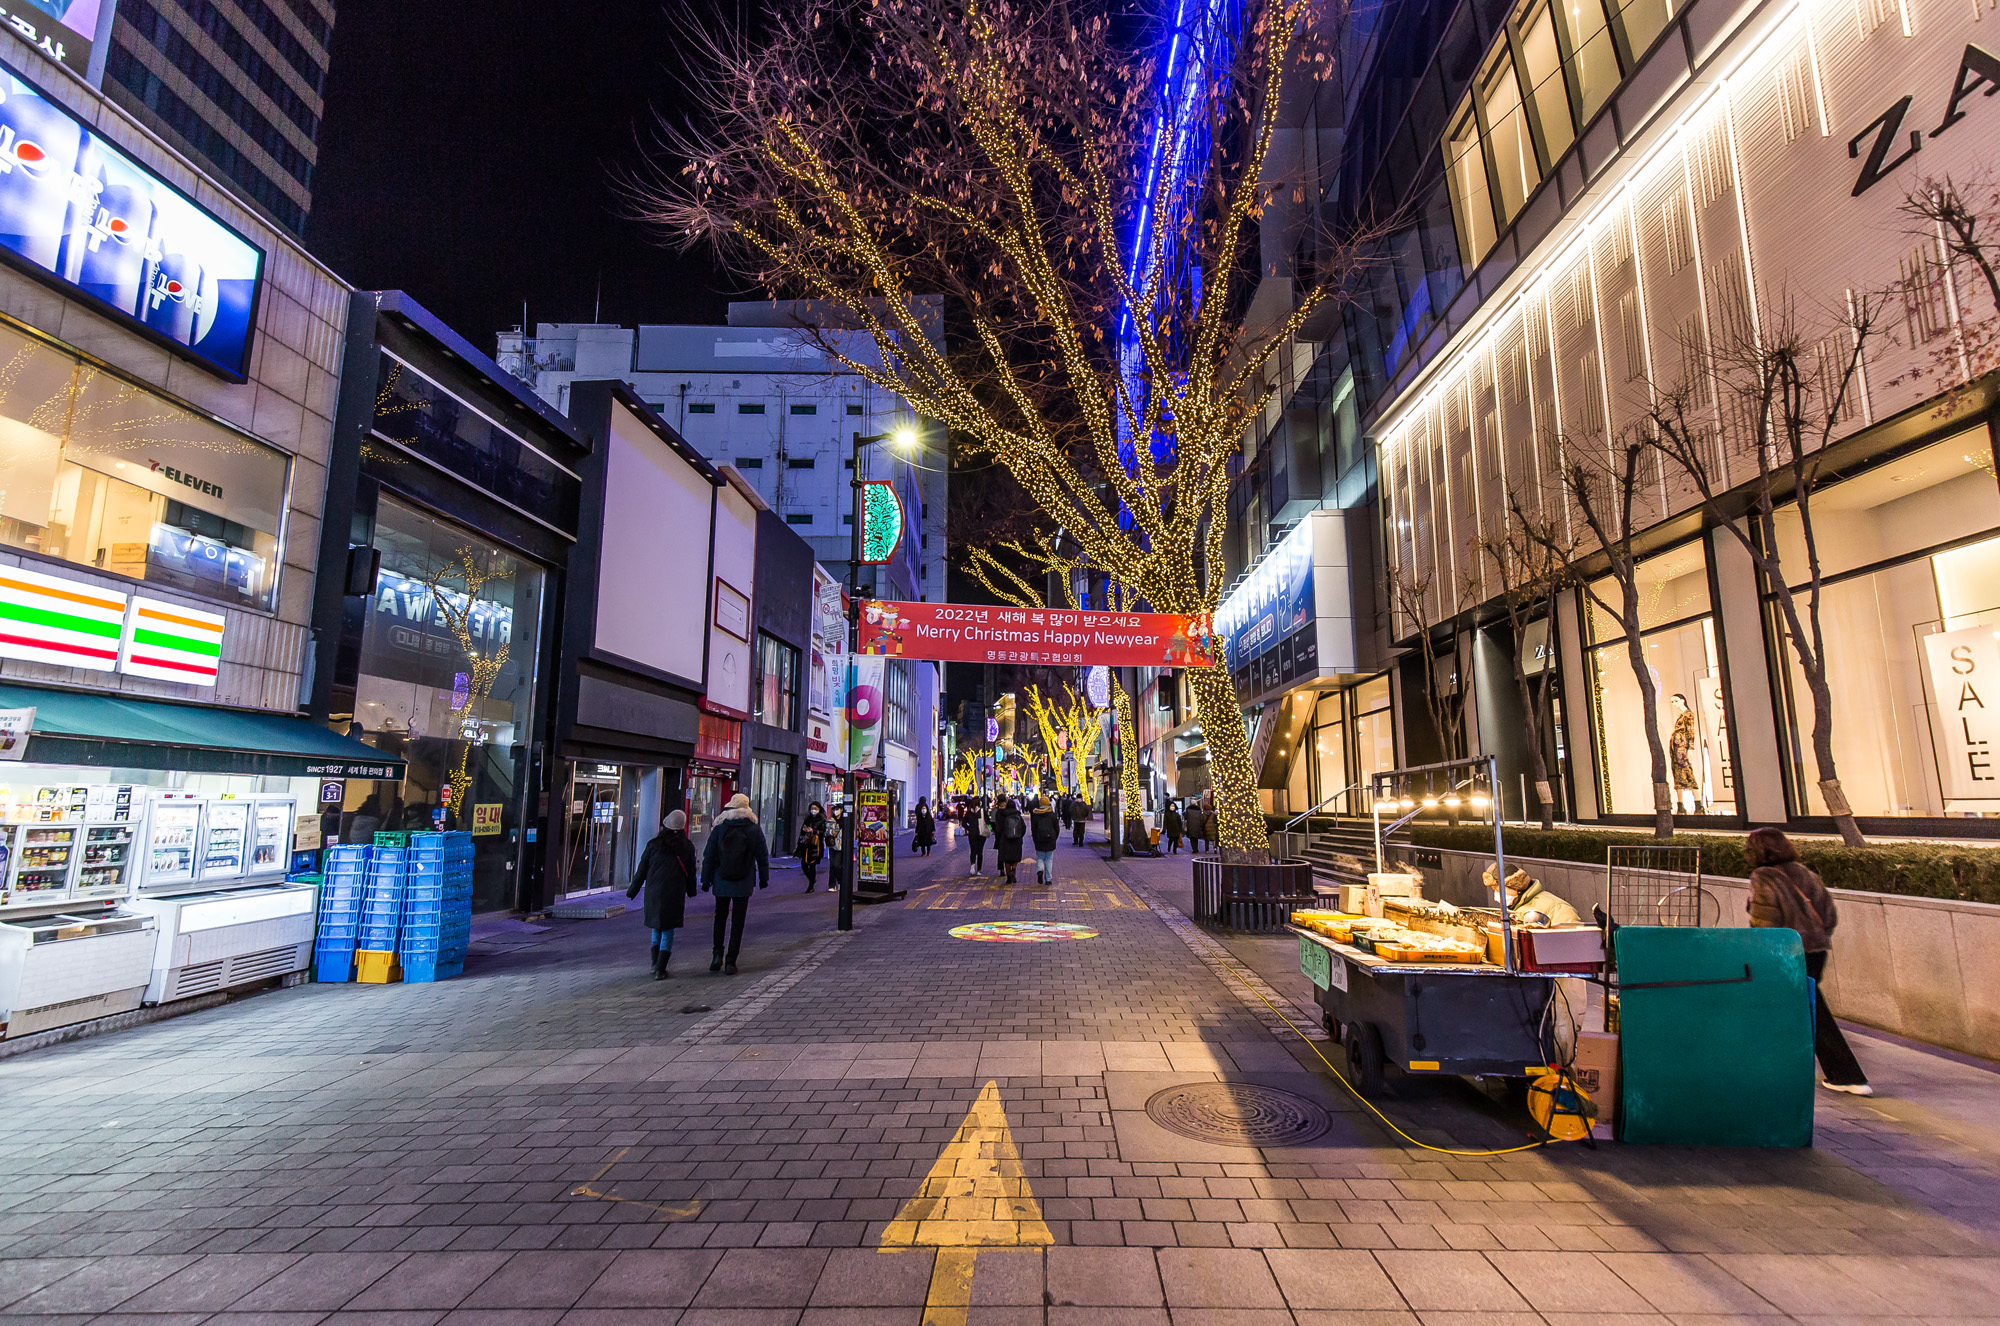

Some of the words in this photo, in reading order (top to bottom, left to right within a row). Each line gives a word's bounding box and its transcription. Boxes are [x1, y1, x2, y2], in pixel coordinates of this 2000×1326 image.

[935, 608, 988, 623] 2022년
[997, 611, 1027, 624] 새해
[1030, 613, 1045, 626] 복
[1050, 613, 1078, 626] 많이
[1083, 615, 1142, 628] 받으세요
[916, 624, 960, 642] Merry
[964, 626, 1040, 643] Christmas
[1044, 629, 1091, 647] Happy
[1094, 631, 1160, 648] Newyear
[1950, 645, 1995, 781] SALE
[325, 765, 343, 774] 1927
[325, 792, 337, 800] 3-1
[476, 806, 501, 824] 임대
